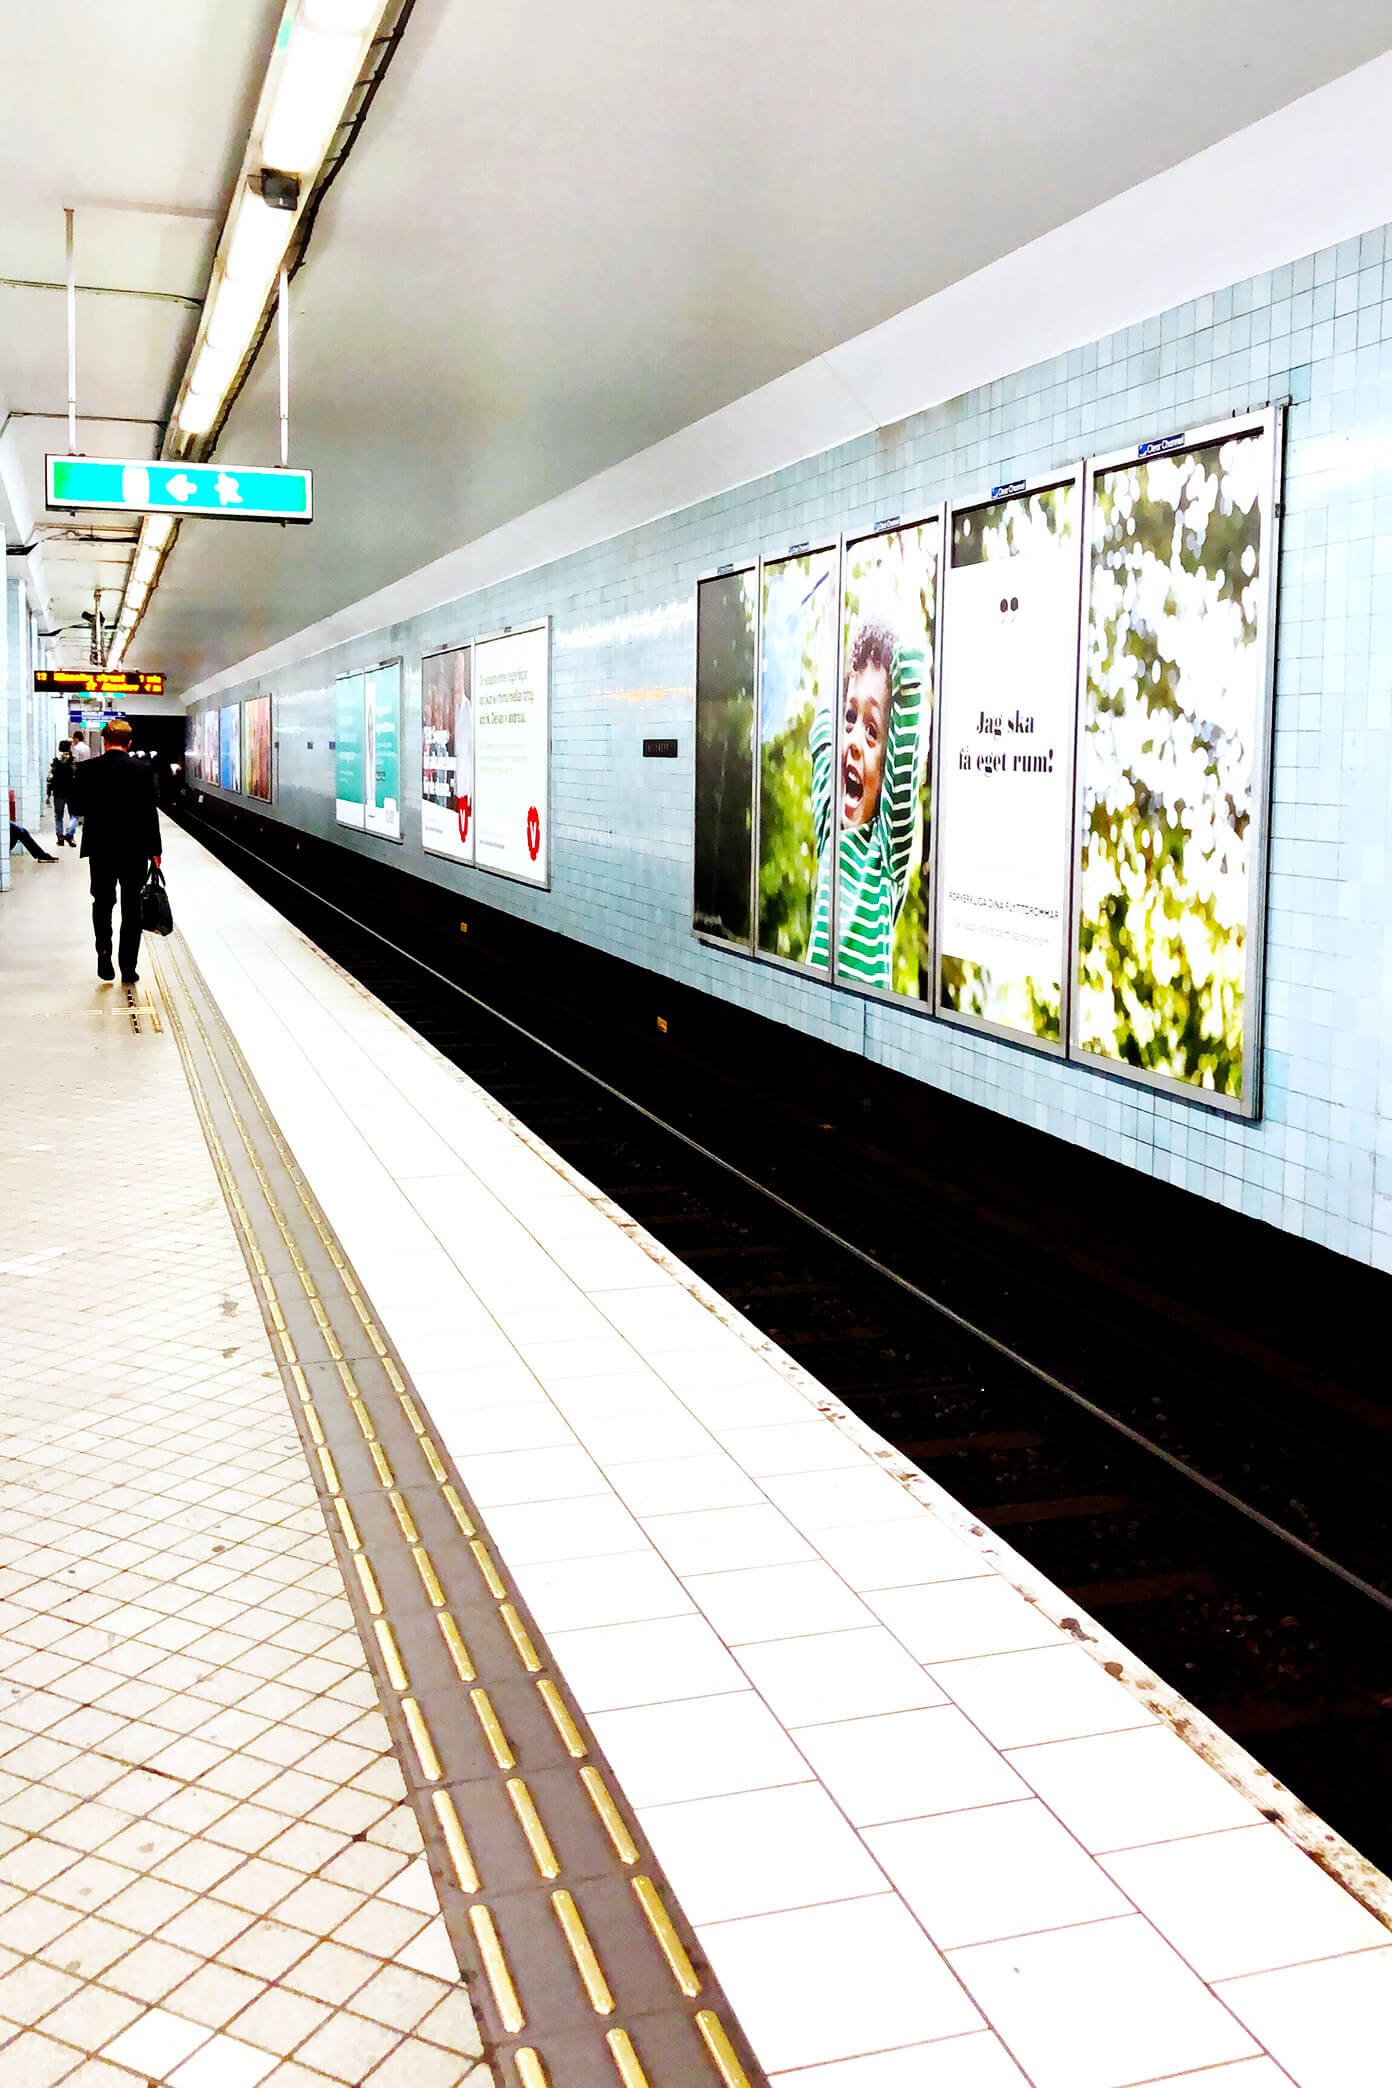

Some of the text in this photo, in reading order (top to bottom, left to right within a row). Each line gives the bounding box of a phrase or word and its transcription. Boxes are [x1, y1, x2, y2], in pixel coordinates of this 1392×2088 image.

[1146, 434, 1185, 454] Clear Channel
[976, 709, 1034, 741] Jag ska
[976, 752, 1006, 777] eget
[1013, 748, 1054, 773] rum!
